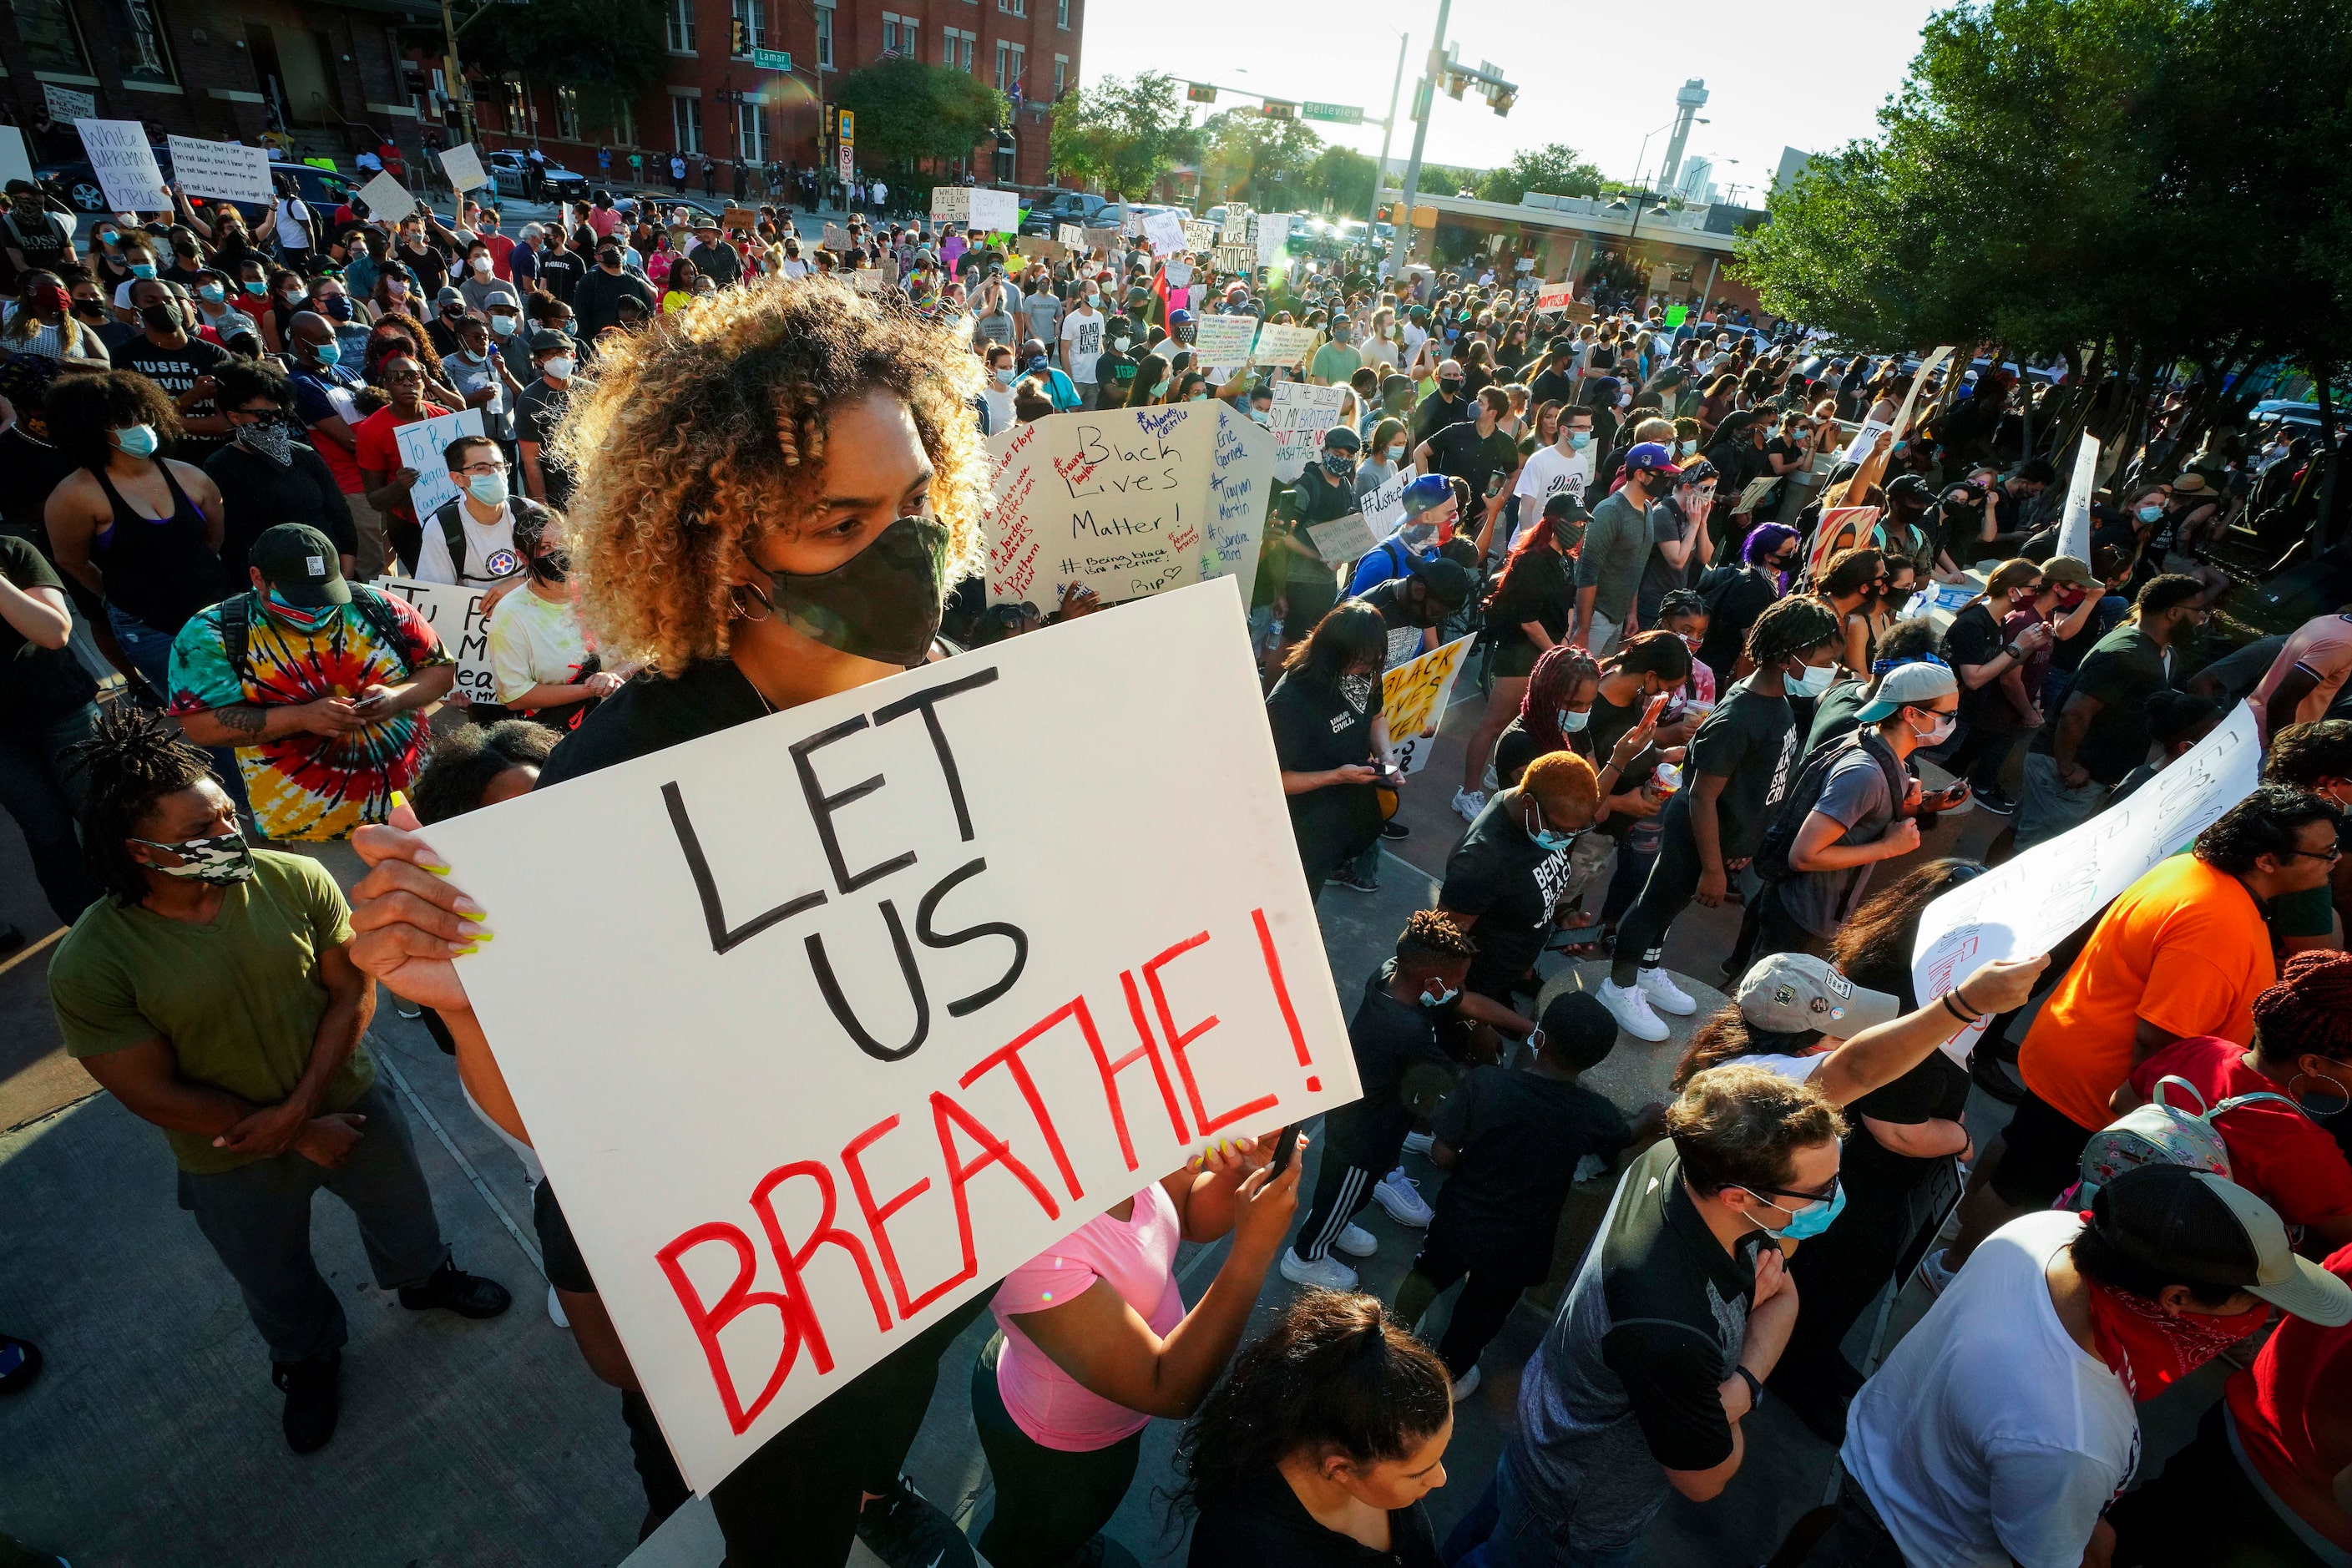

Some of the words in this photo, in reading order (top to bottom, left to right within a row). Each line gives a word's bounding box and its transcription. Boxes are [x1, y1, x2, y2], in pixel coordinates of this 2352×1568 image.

[759, 51, 786, 63] Lamar
[1307, 104, 1360, 118] Belleview
[79, 125, 141, 148] White
[89, 149, 153, 168] SUPREMACY
[244, 150, 255, 159] you
[104, 173, 120, 185] IS
[122, 173, 151, 185] THE
[108, 190, 162, 206] VIRUS
[975, 193, 994, 206] Say
[999, 195, 1016, 208] His
[1227, 203, 1248, 217] STOP
[1186, 223, 1211, 234] BLACK
[21, 235, 58, 247] BOSS
[1157, 230, 1187, 250] AWAKE
[1186, 237, 1212, 250] MATTER
[1227, 232, 1242, 243] US
[1215, 246, 1252, 273] ENOUGH
[1080, 322, 1100, 334] BLACK
[1080, 334, 1099, 345] LIVES
[1080, 345, 1099, 354] MATTER
[133, 361, 200, 375] YUSEF,
[1274, 382, 1294, 400] FIX
[1299, 385, 1313, 399] THE
[1316, 387, 1339, 402] SYSTEM
[1141, 408, 1177, 434] Philando
[1267, 407, 1281, 427] SO
[1284, 408, 1300, 427] MY
[1299, 408, 1337, 428] BROTHER
[427, 424, 448, 456] Be
[1011, 425, 1035, 453] Floyd
[1078, 426, 1181, 465] Black
[1216, 429, 1237, 448] Eric
[1297, 429, 1313, 447] THE
[1065, 468, 1178, 498] Lives
[1363, 486, 1402, 517] #Justice
[1573, 496, 1584, 507] LA
[1218, 503, 1250, 521] Martin
[1343, 518, 1364, 532] Name
[1349, 532, 1372, 545] Name
[994, 527, 1034, 574] Edwards
[1085, 555, 1131, 566] Being
[1131, 549, 1167, 559] black
[1216, 547, 1242, 561] Bland
[660, 666, 999, 954] LET
[804, 857, 1029, 1062] US
[654, 908, 1322, 1435] BREATHE!
